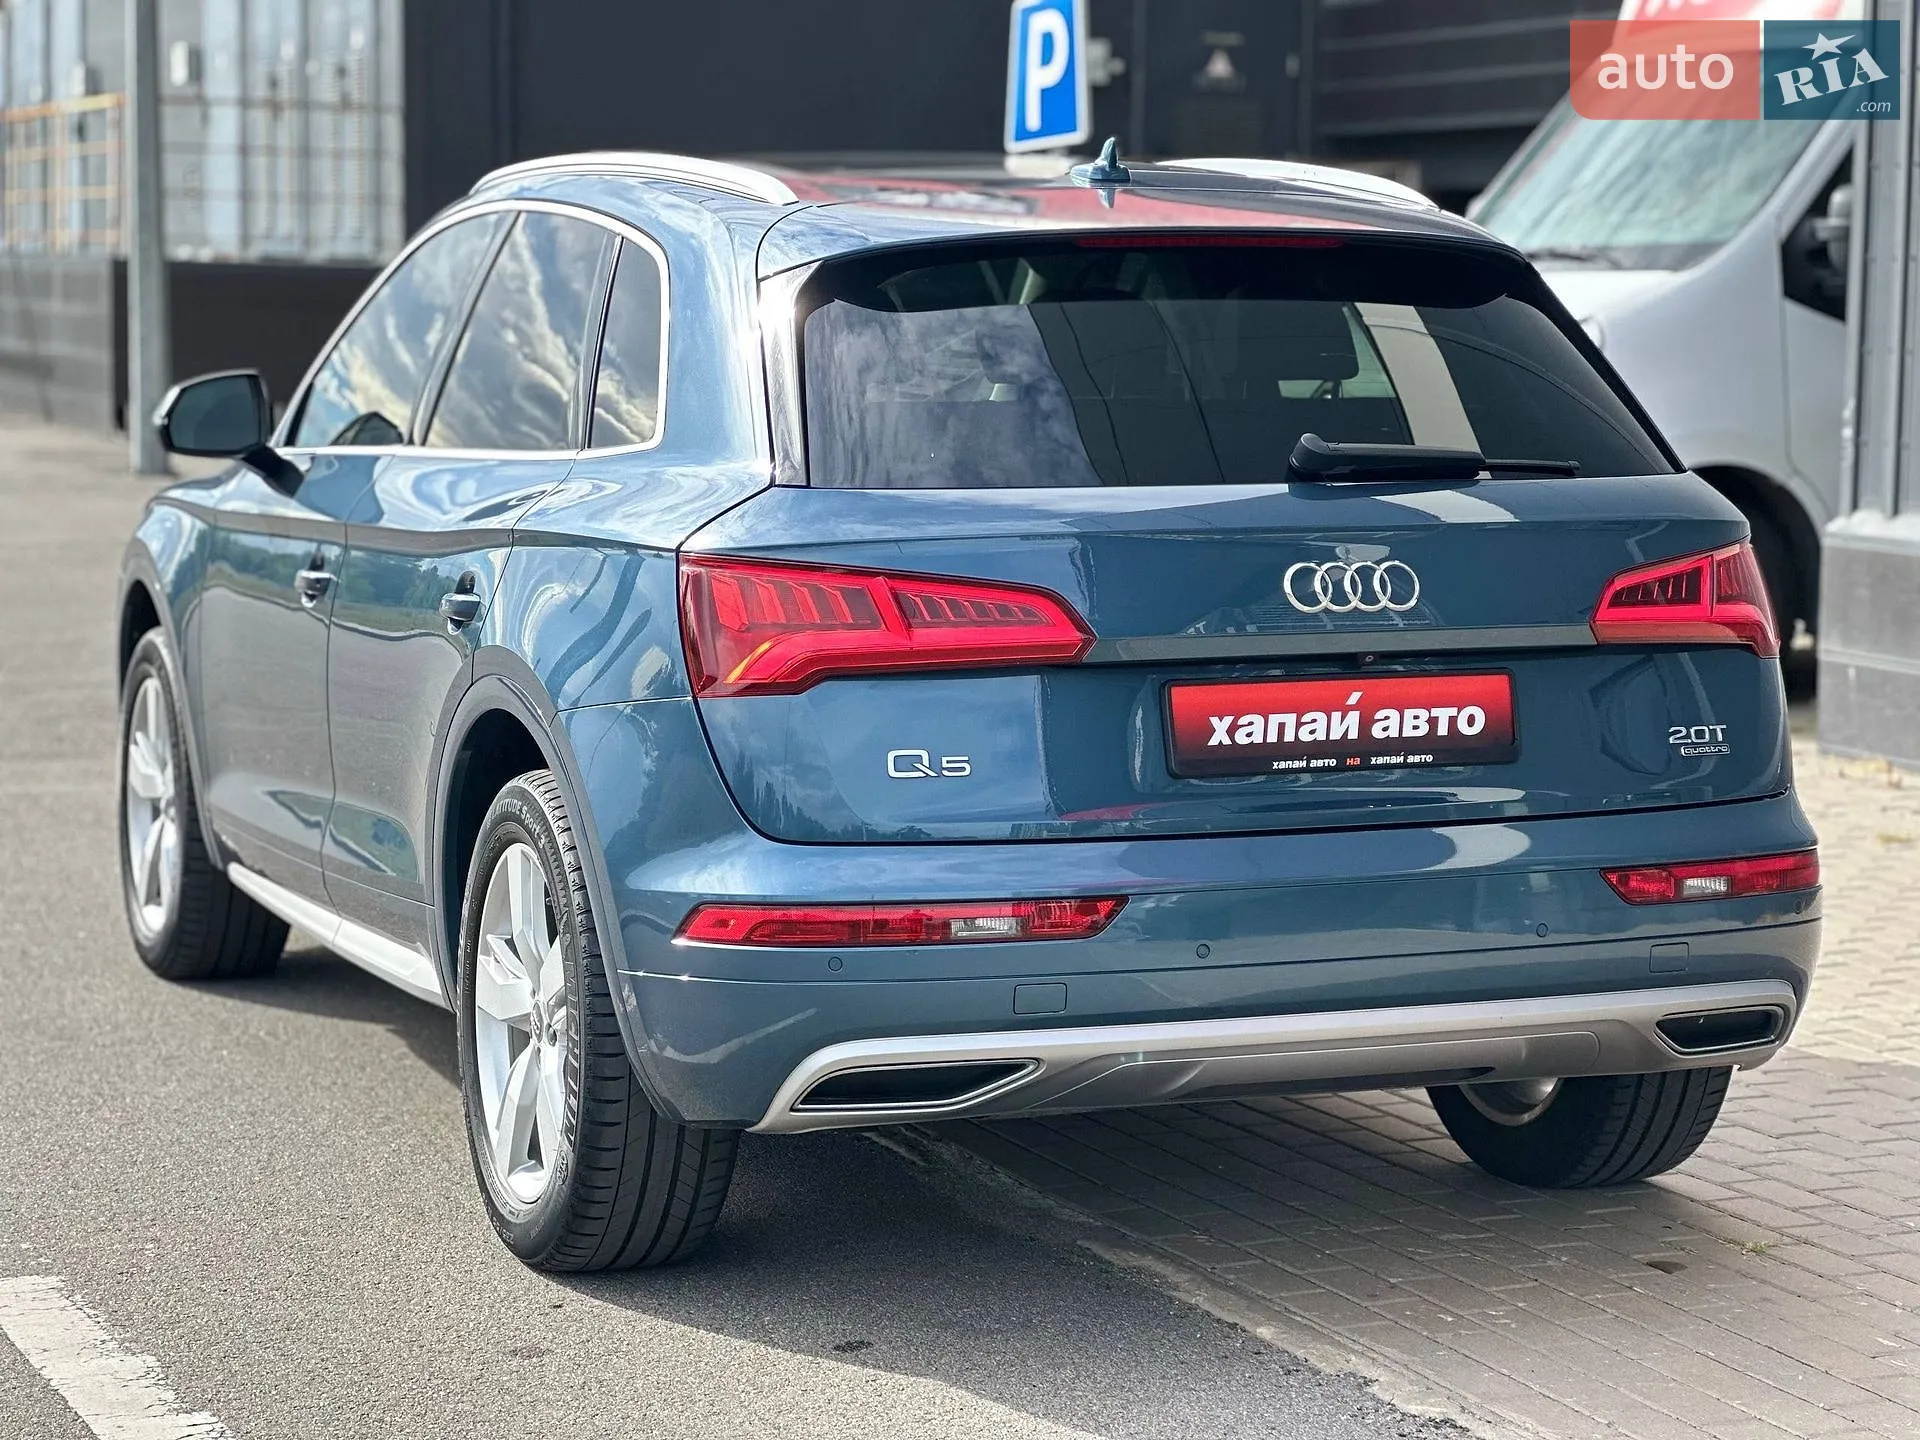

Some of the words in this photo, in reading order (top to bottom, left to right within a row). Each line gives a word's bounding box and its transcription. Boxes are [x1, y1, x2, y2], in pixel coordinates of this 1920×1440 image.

[1025, 8, 1069, 132] P
[1371, 705, 1486, 739] авто
[1309, 758, 1337, 768] авто
[1345, 756, 1361, 766] на
[1407, 753, 1433, 763] авто
[1684, 745, 1729, 755] quattro
[563, 961, 580, 1153] MICHELIN
